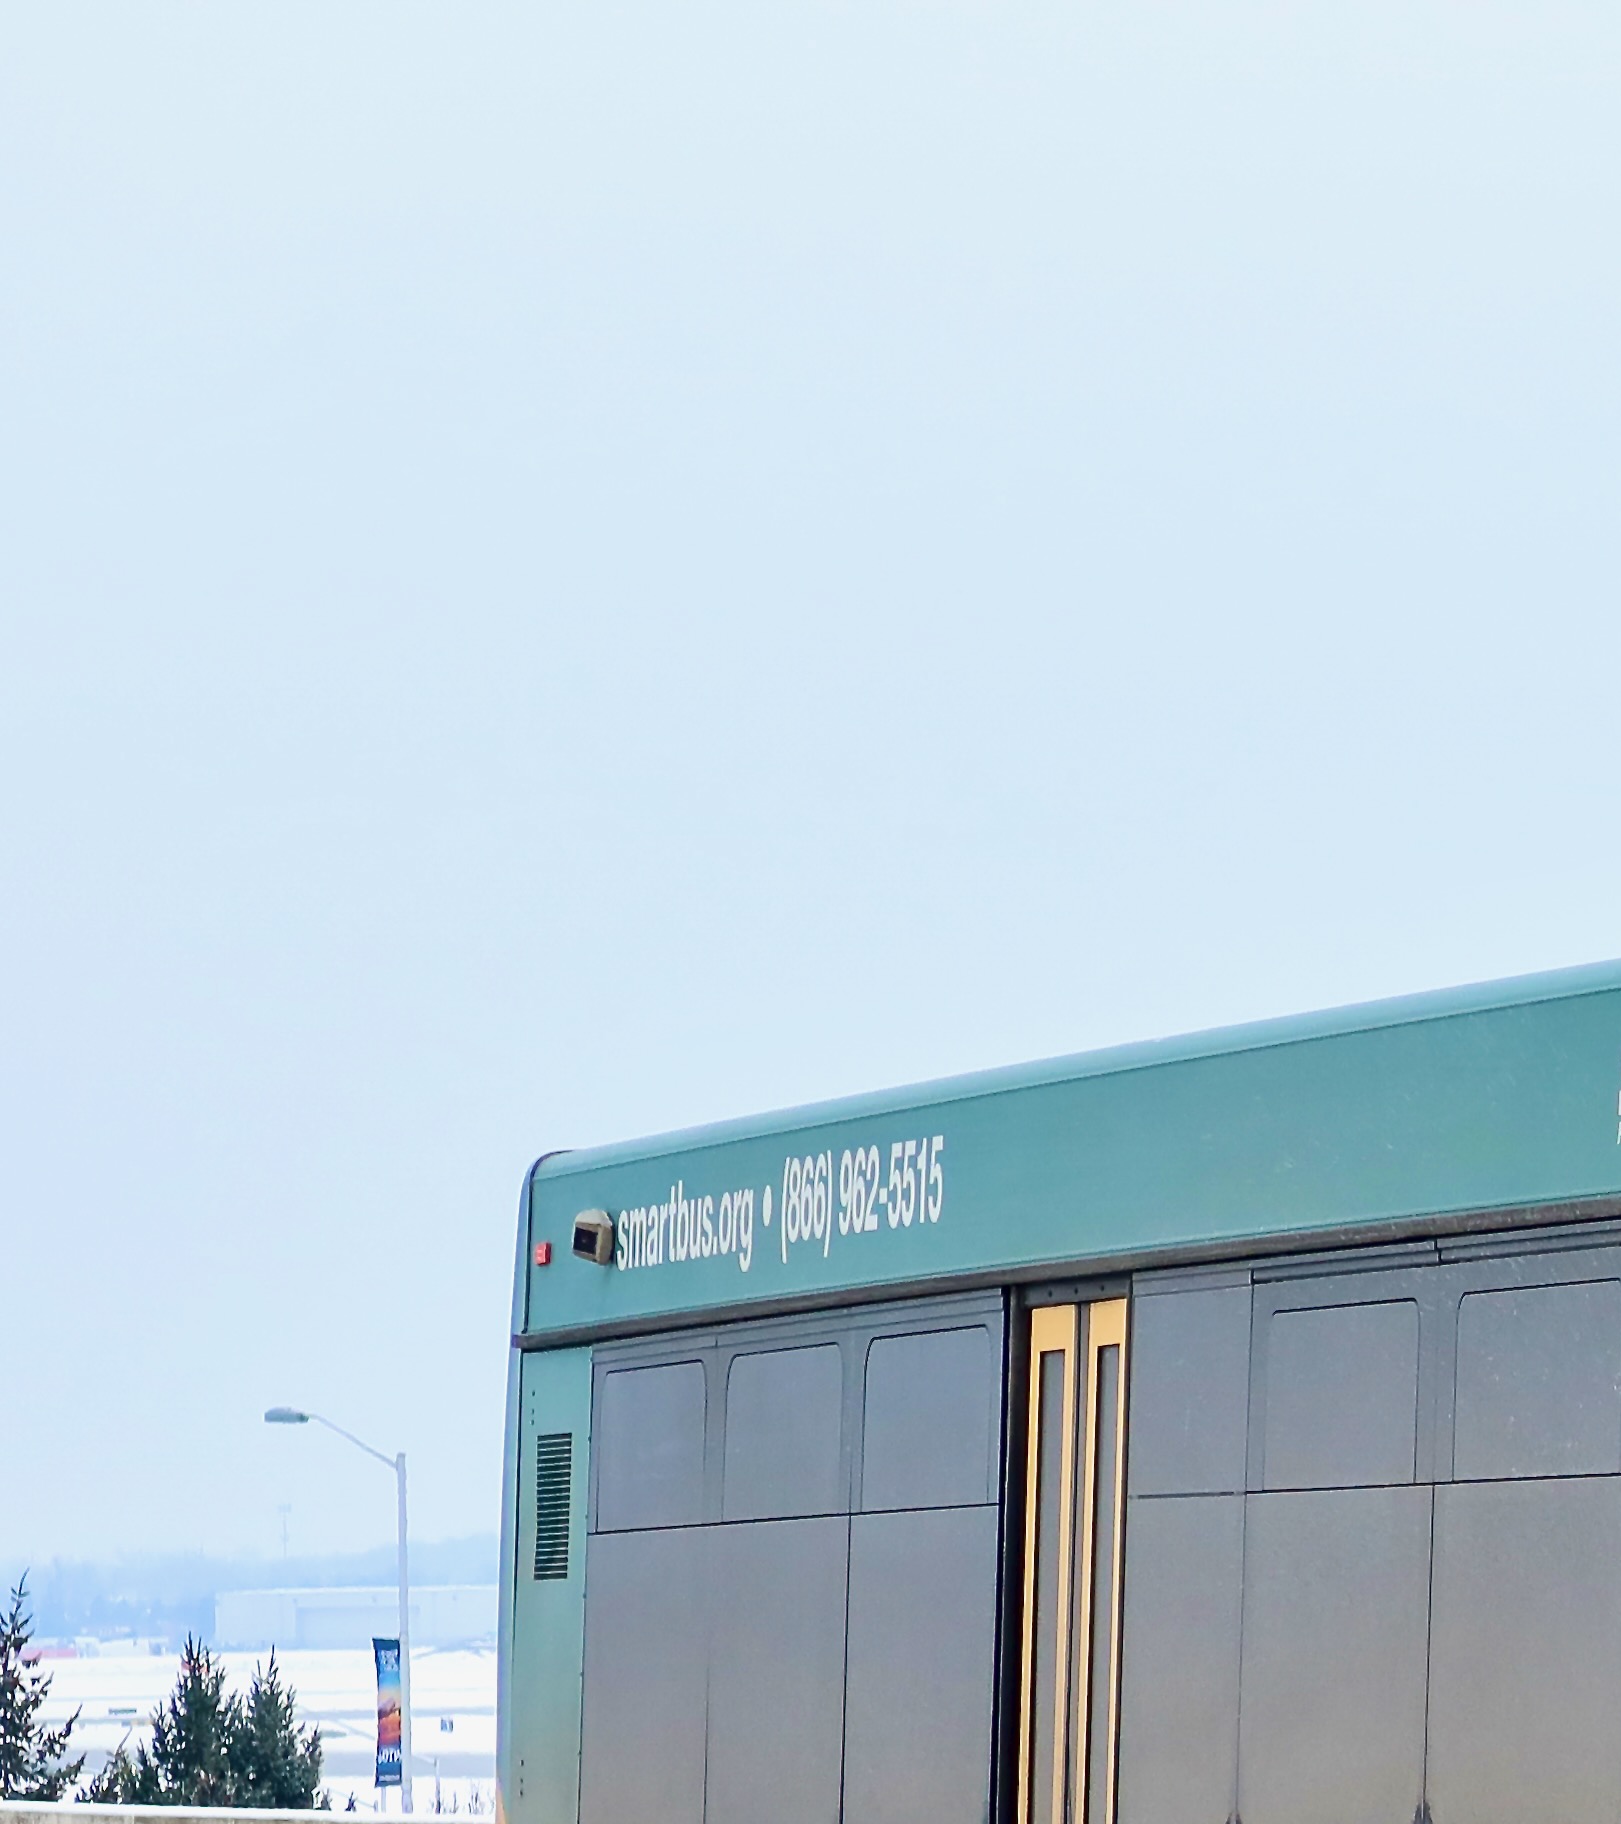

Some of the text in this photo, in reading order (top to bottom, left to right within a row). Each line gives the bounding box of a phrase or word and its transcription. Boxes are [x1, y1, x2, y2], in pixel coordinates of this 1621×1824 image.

[616, 1135, 944, 1273] smartbus.org (866) 962-5515
